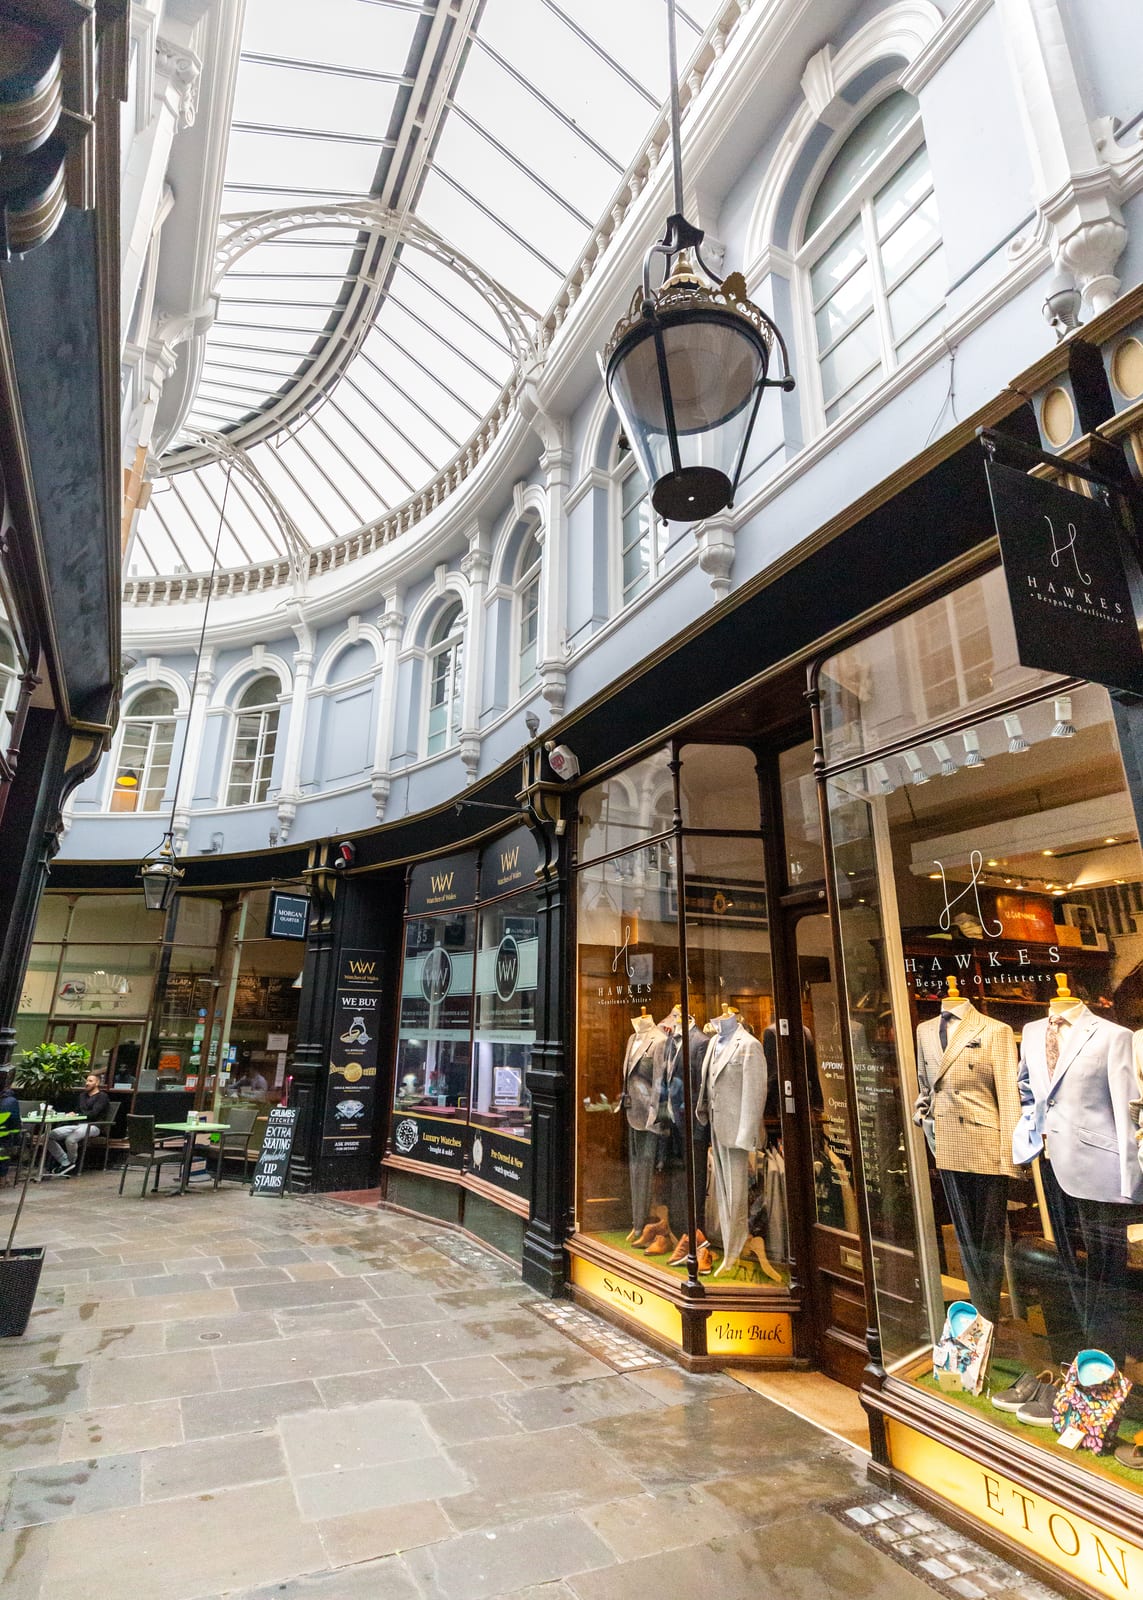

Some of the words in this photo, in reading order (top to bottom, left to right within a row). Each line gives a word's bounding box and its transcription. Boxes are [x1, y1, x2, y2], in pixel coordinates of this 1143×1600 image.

[1027, 575, 1122, 614] HAWKES
[1037, 592, 1072, 609] Bespoke
[278, 909, 303, 918] MORGAN
[905, 946, 1060, 973] HAWKES
[973, 973, 1051, 986] Outfitters
[598, 982, 652, 997] HAWKES
[341, 997, 357, 1006] WE
[358, 998, 378, 1007] BUY
[270, 1109, 296, 1118] CRUMBS
[265, 1126, 292, 1138] EXTRA
[262, 1137, 292, 1150] SEATING
[422, 1132, 440, 1145] Luxury
[440, 1135, 462, 1148] Watches
[263, 1162, 278, 1174] UP
[254, 1175, 283, 1188] STAIRS
[603, 1277, 644, 1305] SAND
[715, 1322, 742, 1341] Van
[747, 1324, 786, 1345] Buck
[981, 1473, 1128, 1589] ETON
